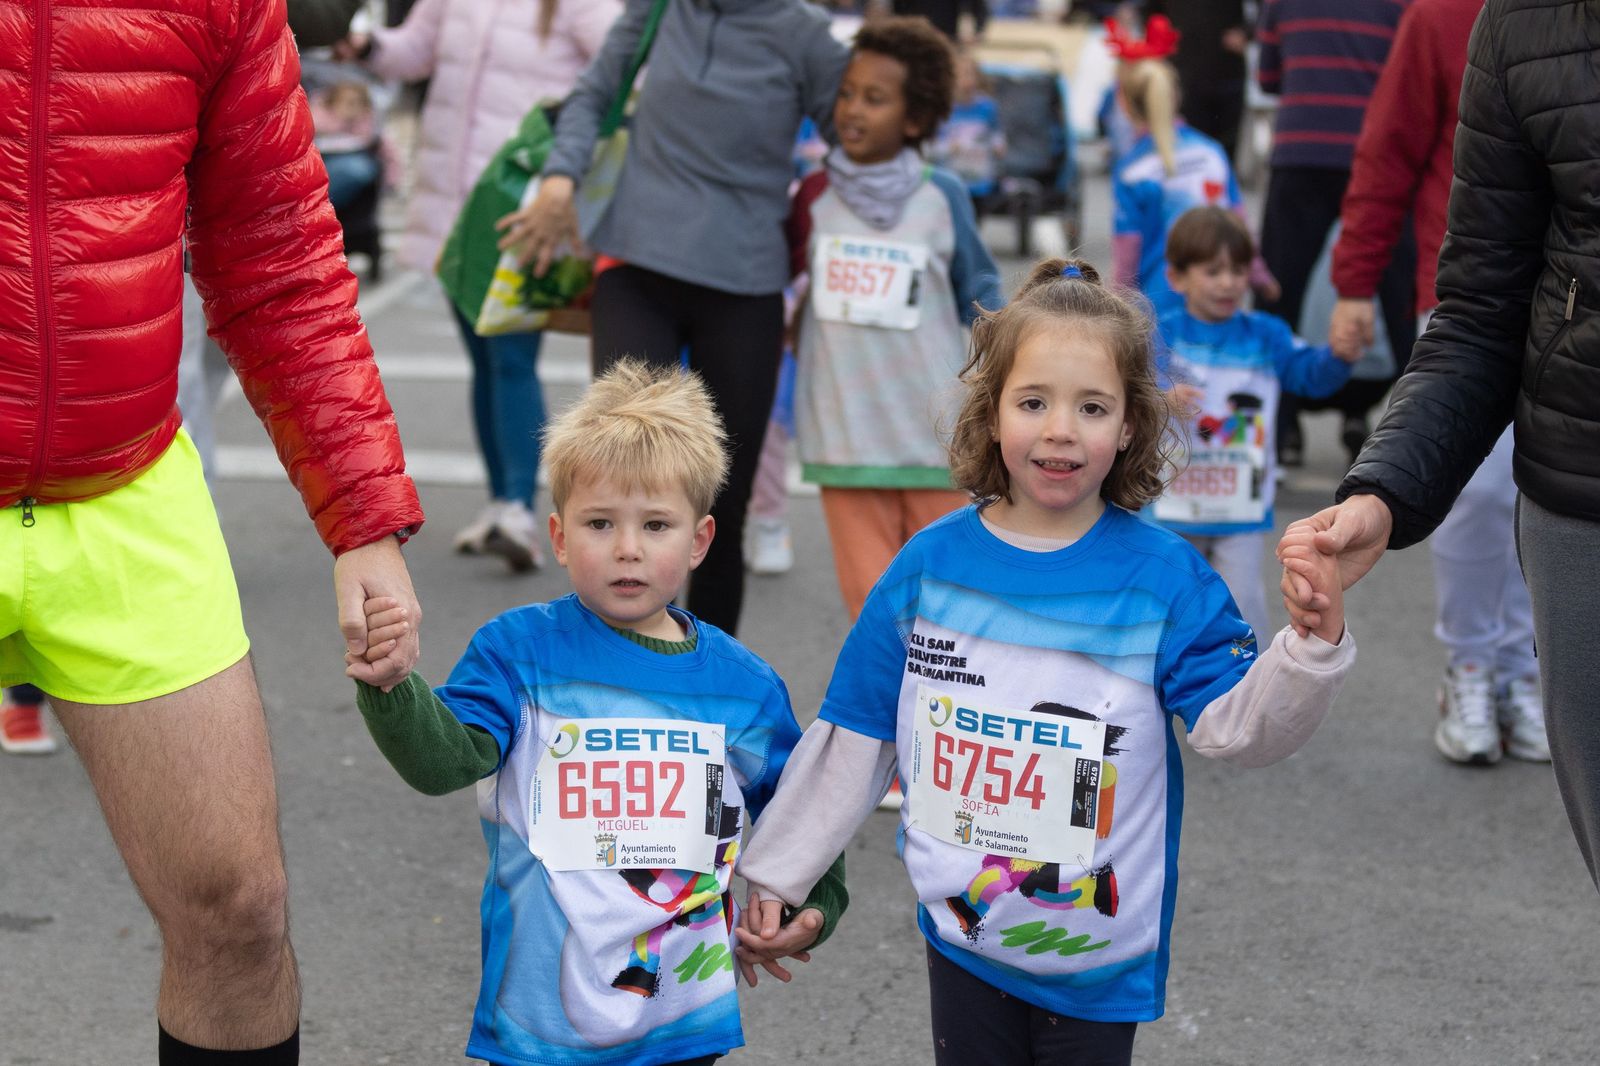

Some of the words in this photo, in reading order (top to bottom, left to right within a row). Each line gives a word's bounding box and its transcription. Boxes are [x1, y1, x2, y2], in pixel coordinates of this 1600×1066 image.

[927, 638, 956, 652] SAN
[908, 647, 967, 669] SILVESTRE
[907, 661, 986, 687] SAMANTINA
[955, 707, 1082, 750] SETEL
[585, 728, 710, 755] SETEL
[933, 731, 1046, 810] 6754
[1090, 766, 1098, 786] 6754
[558, 760, 686, 819] 6592
[597, 819, 648, 831] MIGUEL
[975, 825, 1029, 843] Ayuntamiento
[620, 843, 677, 855] Ayuntamiento
[974, 837, 984, 847] de
[985, 839, 1027, 854] Salamanca
[620, 855, 631, 865] de
[633, 855, 677, 865] Salamanca
